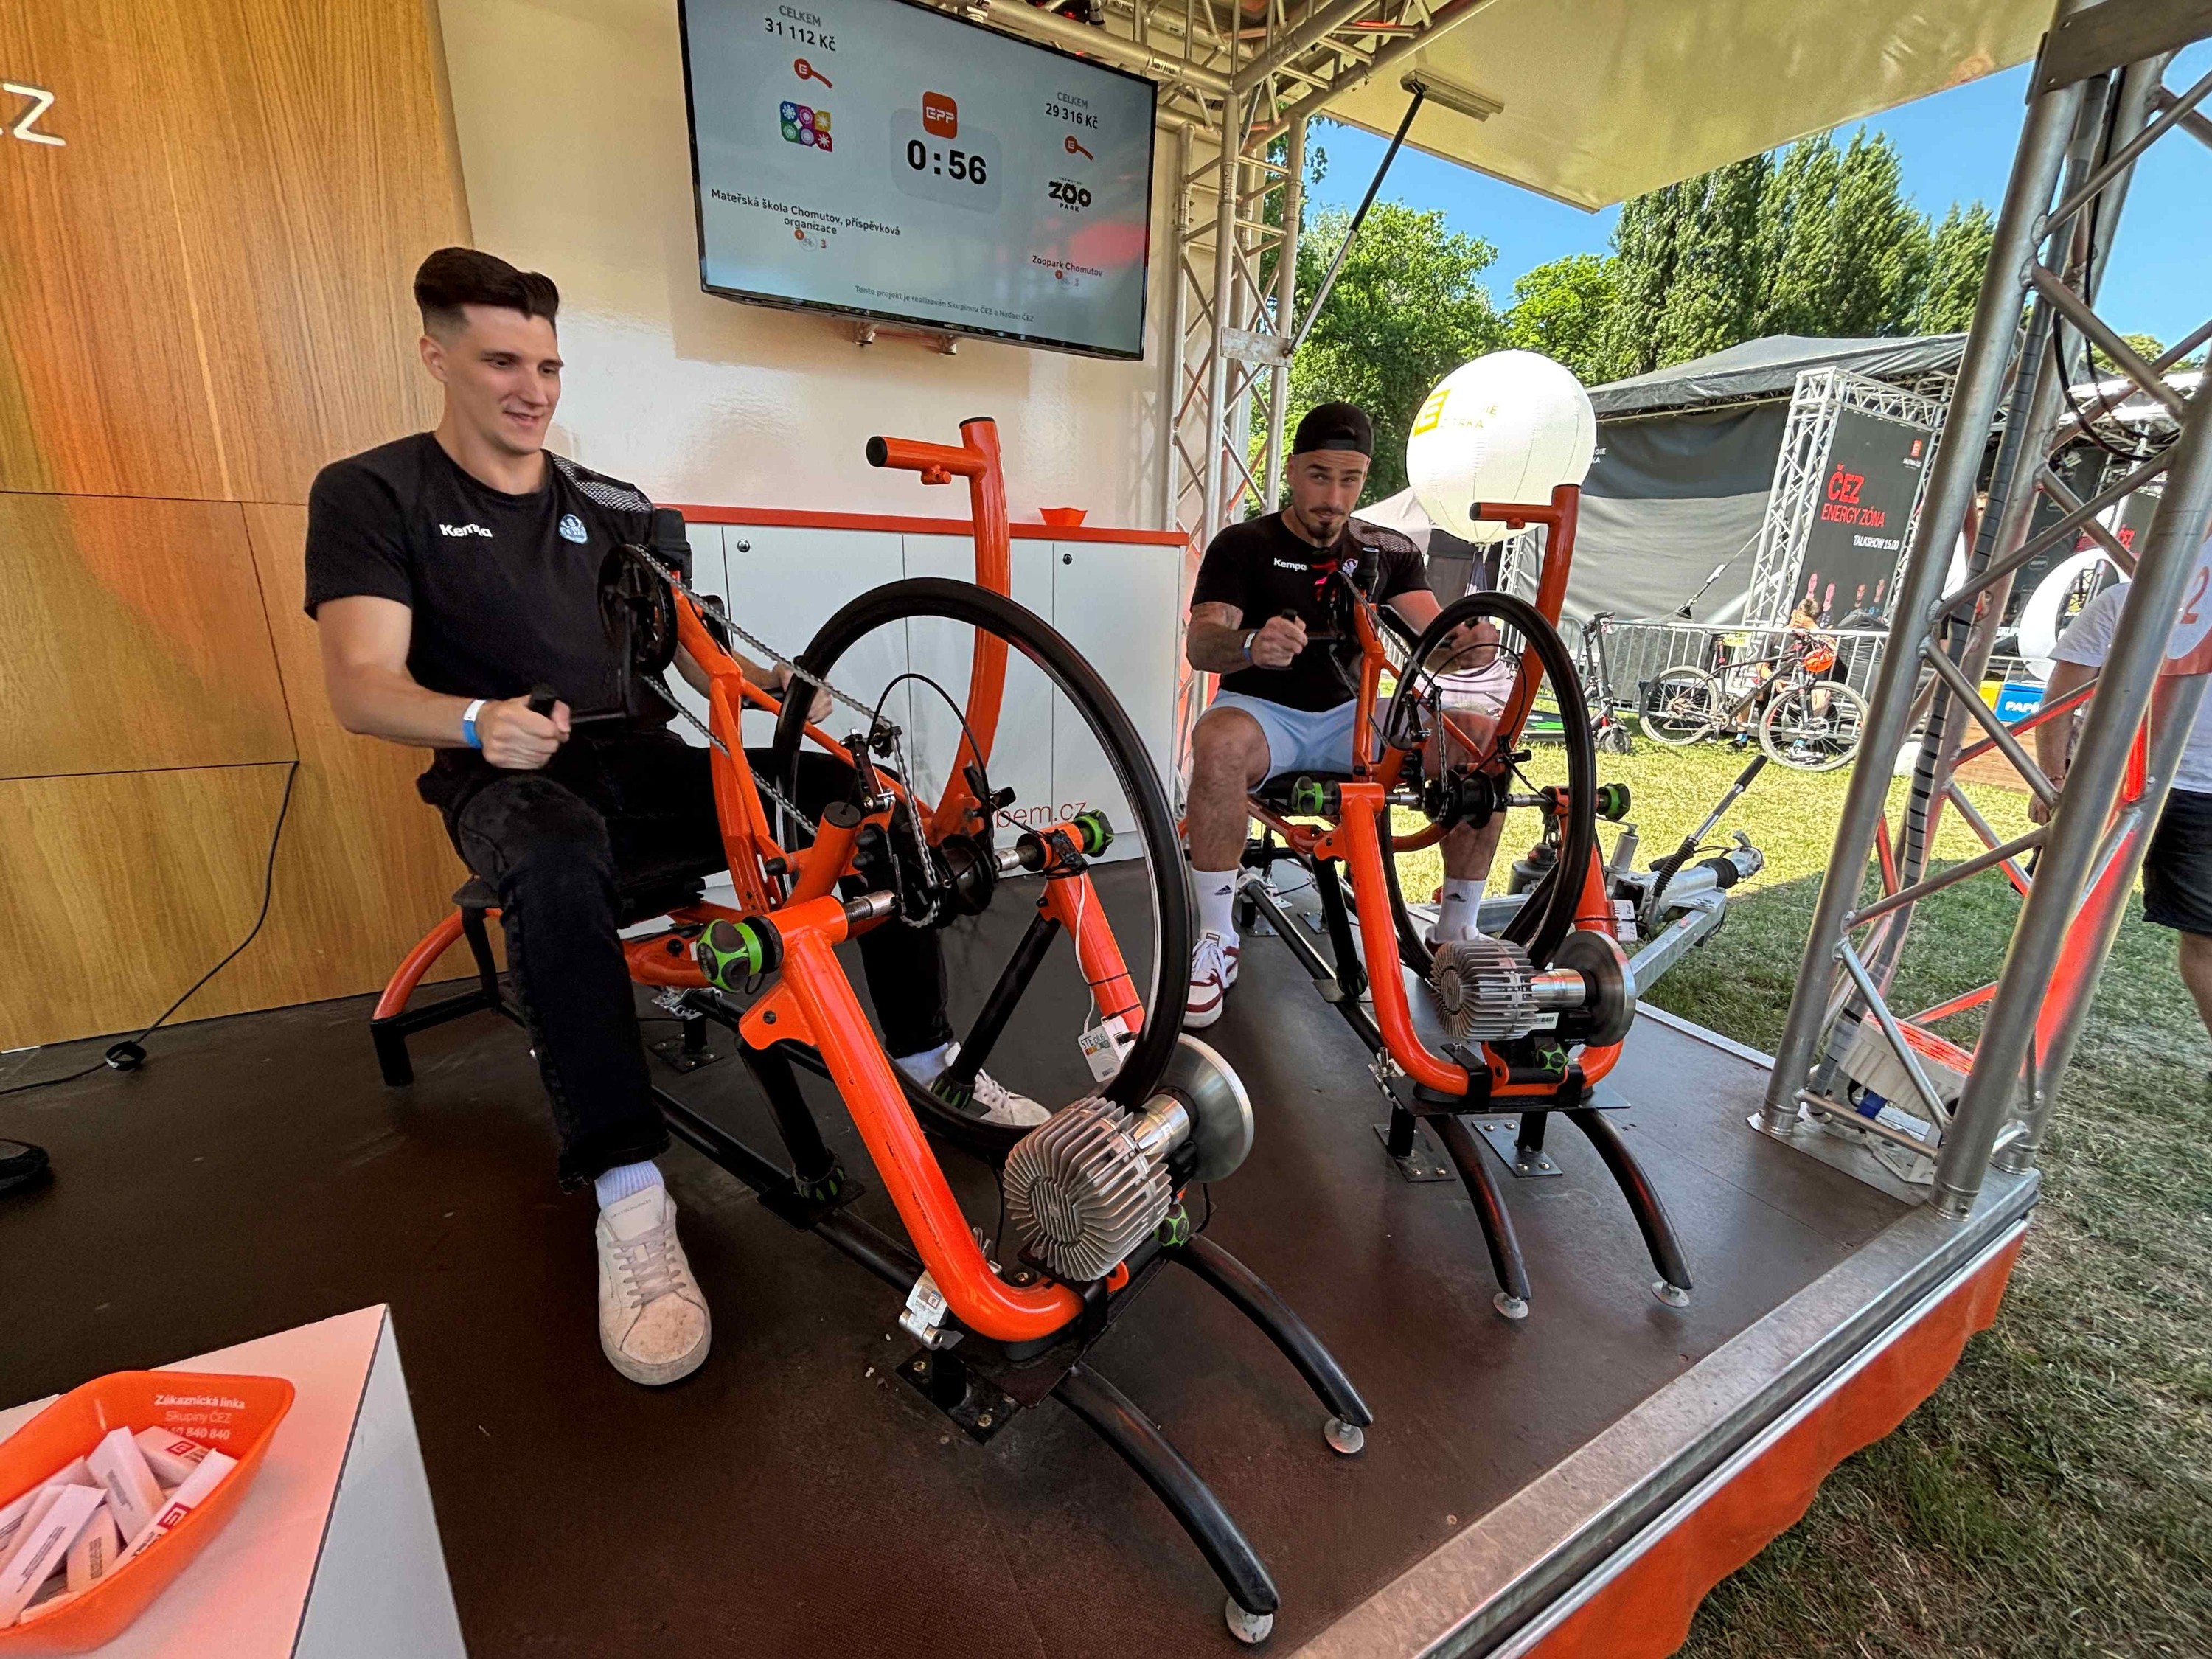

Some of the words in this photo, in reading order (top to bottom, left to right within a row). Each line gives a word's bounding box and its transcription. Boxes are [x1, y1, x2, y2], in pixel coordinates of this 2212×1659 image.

[779, 5, 821, 27] CELKEM
[765, 18, 782, 35] 31
[789, 25, 815, 45] 112
[819, 34, 836, 52] Kč
[1057, 91, 1088, 109] CELKEM
[1046, 103, 1060, 117] 29
[1062, 108, 1082, 125] 316
[1085, 115, 1099, 129] Kč
[1048, 181, 1092, 208] ZOO
[711, 189, 759, 207] Mateřská
[762, 199, 788, 214] škola
[791, 205, 843, 226] Chomutov,
[845, 217, 900, 236] příspěvková
[784, 218, 838, 234] organizace
[1032, 255, 1064, 269] Zoopark
[1065, 262, 1102, 276] Chomutov
[855, 285, 875, 295] Tento
[877, 290, 902, 300] projekt
[1827, 463, 1864, 504] ČEZ
[1820, 503, 1861, 524] ENERGY
[1858, 505, 1885, 528] ZÓNA
[1852, 535, 1885, 549] TALKSHOW
[1273, 557, 1307, 572] Kempa
[154, 1394, 219, 1406] Zákaznická
[220, 1397, 245, 1409] linka
[165, 1411, 206, 1423] Skupiny
[209, 1411, 232, 1423] ČEZ
[186, 1427, 207, 1438] 840
[209, 1429, 230, 1440] 840
